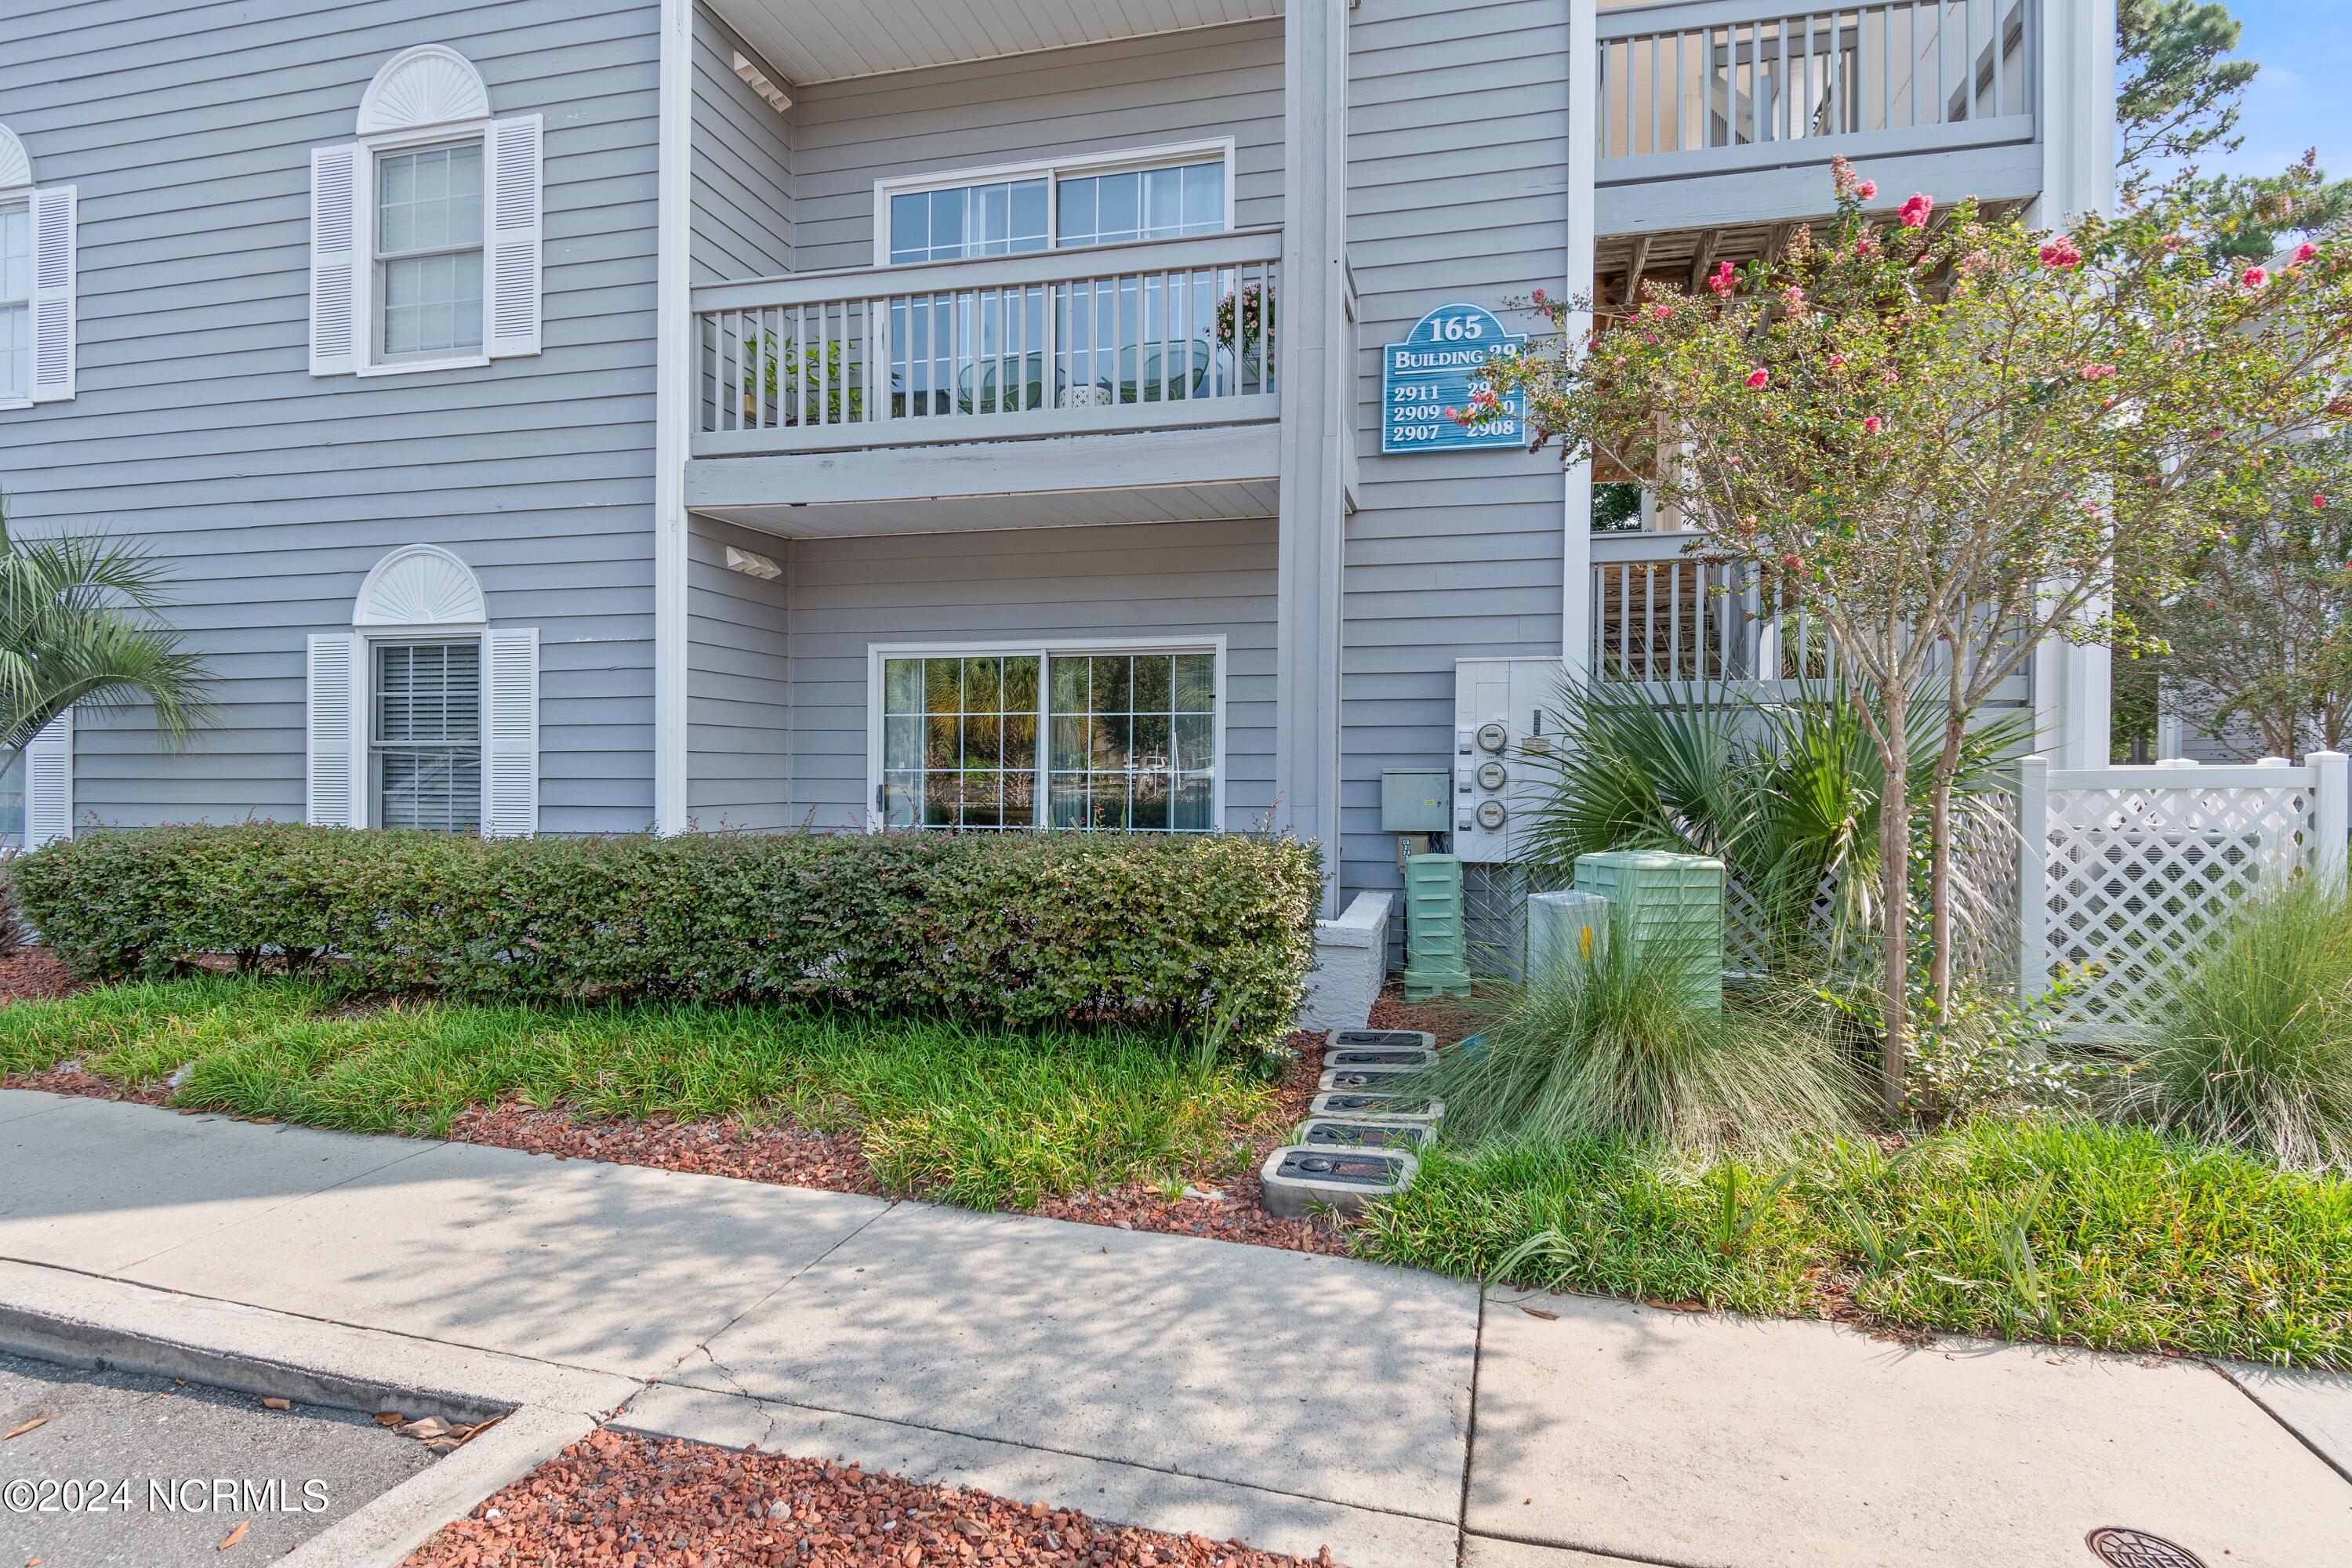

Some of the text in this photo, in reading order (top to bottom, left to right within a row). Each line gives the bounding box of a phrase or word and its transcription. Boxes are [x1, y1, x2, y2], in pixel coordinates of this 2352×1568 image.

[1429, 315, 1482, 342] 165
[1490, 343, 1517, 361] 29
[1394, 385, 1439, 402] 2911
[1393, 405, 1440, 421] 2909
[1392, 424, 1440, 441] 2907
[1466, 419, 1515, 437] 2908
